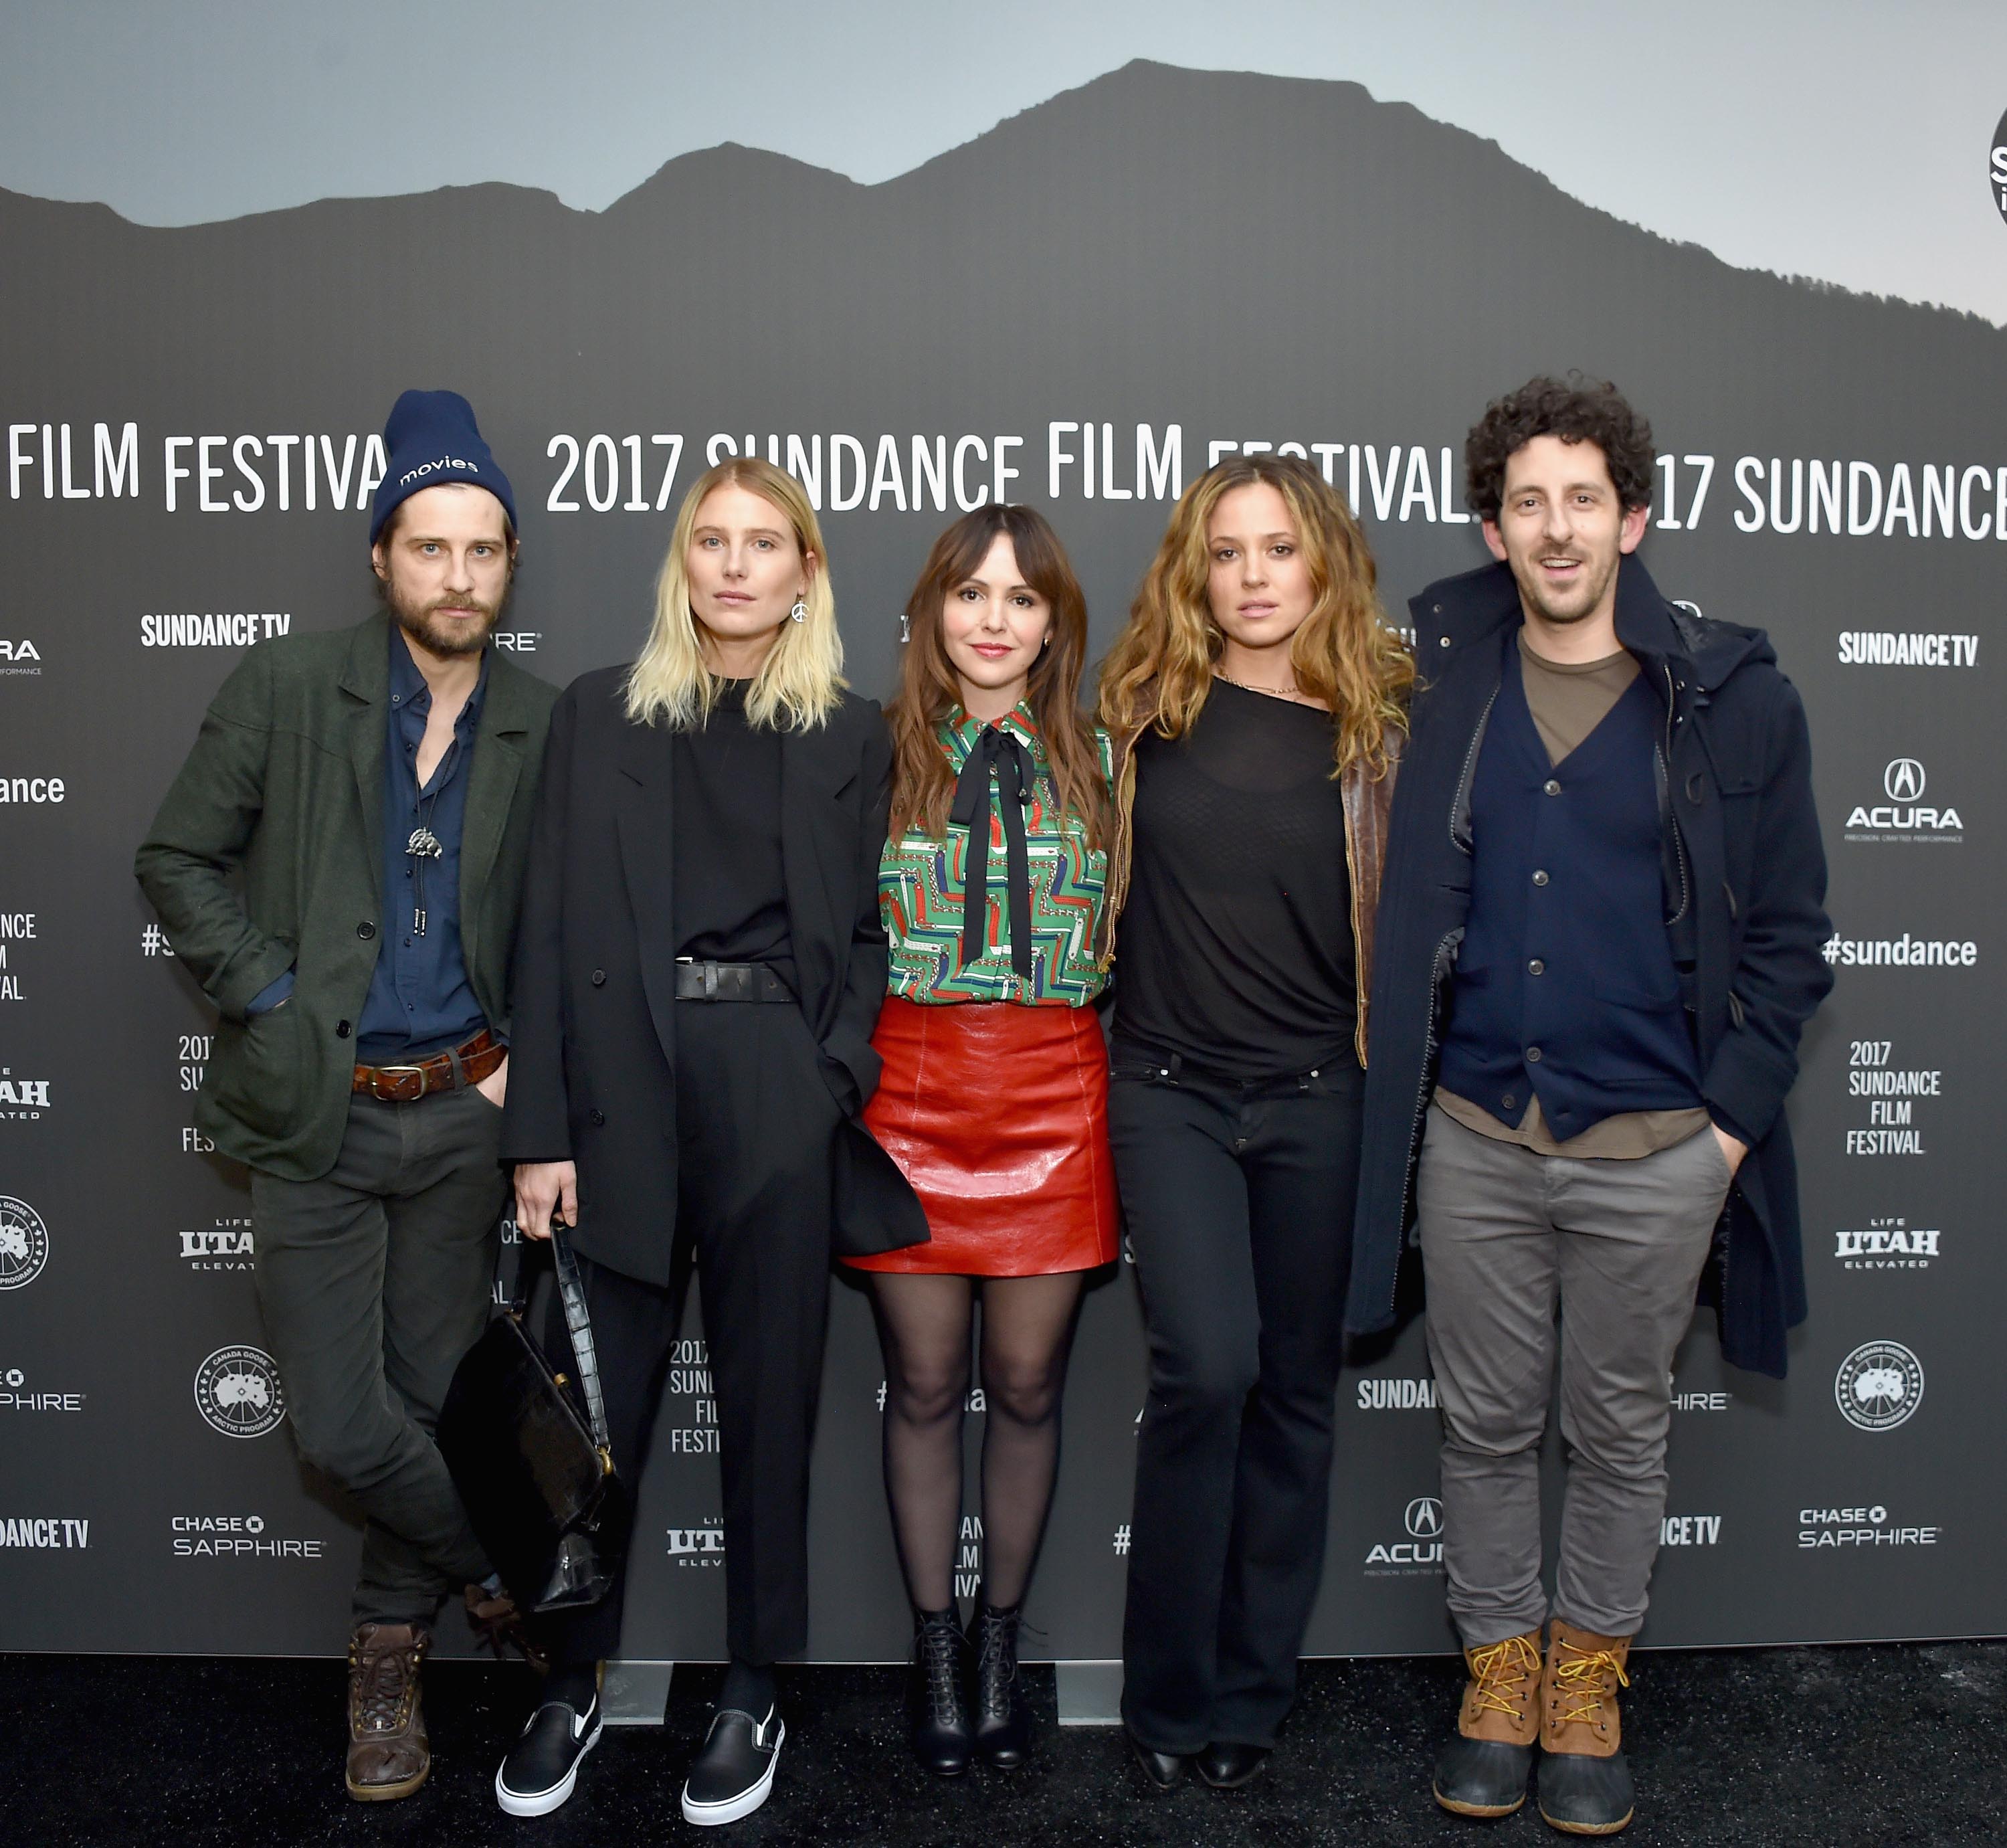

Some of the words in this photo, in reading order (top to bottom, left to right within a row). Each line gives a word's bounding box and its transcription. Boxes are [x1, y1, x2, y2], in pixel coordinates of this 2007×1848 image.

[9, 422, 139, 499] FILM
[165, 434, 387, 513] FESTIVA
[399, 455, 478, 486] movies
[547, 434, 684, 513] 2017
[1049, 422, 1182, 500] FILM
[1845, 806, 1964, 829] ACURA
[1822, 932, 1978, 965] #sundance
[179, 1036, 214, 1060] 201
[1850, 1041, 1892, 1066] 2017
[1849, 1071, 1941, 1095] SUNDANCE
[1871, 1101, 1911, 1125] FILM
[1846, 1130, 1925, 1155] FESTIVAL
[3, 1202, 28, 1217] GOOSE
[215, 1218, 252, 1226] LIFE
[1871, 1218, 1905, 1226] LIFE
[179, 1232, 254, 1257] UTA
[1834, 1230, 1940, 1257] UTAH
[191, 1262, 255, 1271] ELEVAT
[1844, 1260, 1929, 1269] ELEVATED
[213, 1352, 242, 1366] CANADA
[243, 1352, 268, 1366] GOOSE
[696, 1400, 719, 1423] FIL
[212, 1415, 238, 1432] ARCTIC
[240, 1415, 274, 1433] PROGRAM
[672, 1429, 720, 1453] FESTI
[172, 1517, 243, 1531] CHASE
[1800, 1508, 1867, 1524] CHASE
[173, 1539, 322, 1558] SAPPHIRE
[1798, 1527, 1937, 1548] SAPPHIRE
[1365, 1543, 1443, 1563] ACU
